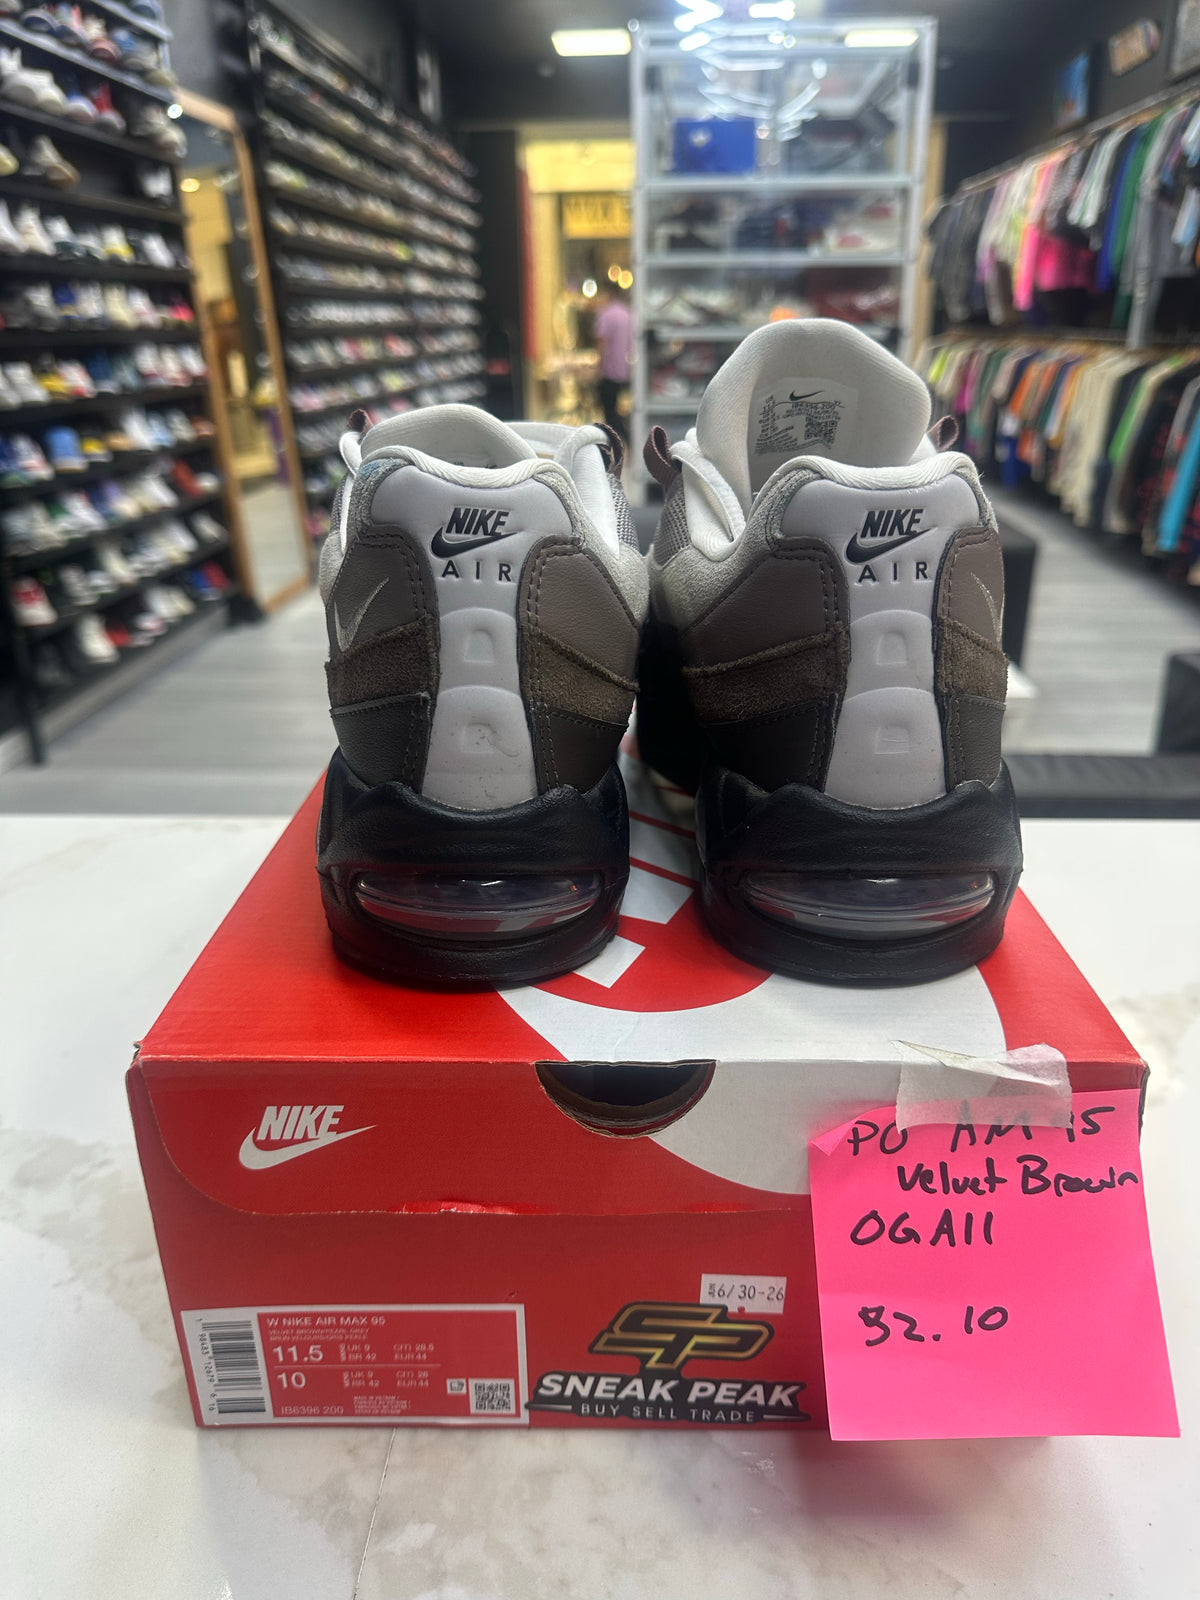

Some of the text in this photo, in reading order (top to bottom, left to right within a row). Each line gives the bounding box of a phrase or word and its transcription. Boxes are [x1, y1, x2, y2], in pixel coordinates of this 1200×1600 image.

[446, 507, 509, 536] NIKE
[860, 509, 923, 539] NIKE
[442, 560, 512, 582] AIR
[858, 562, 928, 584] AIR
[256, 1105, 345, 1141] NIKE
[267, 1315, 386, 1327] W NIKE AIR MAX 95
[272, 1344, 324, 1362] 11.5
[366, 1352, 377, 1361] 42
[416, 1352, 427, 1361] 44
[277, 1371, 306, 1389] 10
[369, 1379, 380, 1388] 42
[418, 1379, 429, 1388] 44
[538, 1373, 804, 1408] SNEAK PEAK
[323, 1405, 344, 1415] 200
[581, 1402, 755, 1423] BUY SELL TRADE
